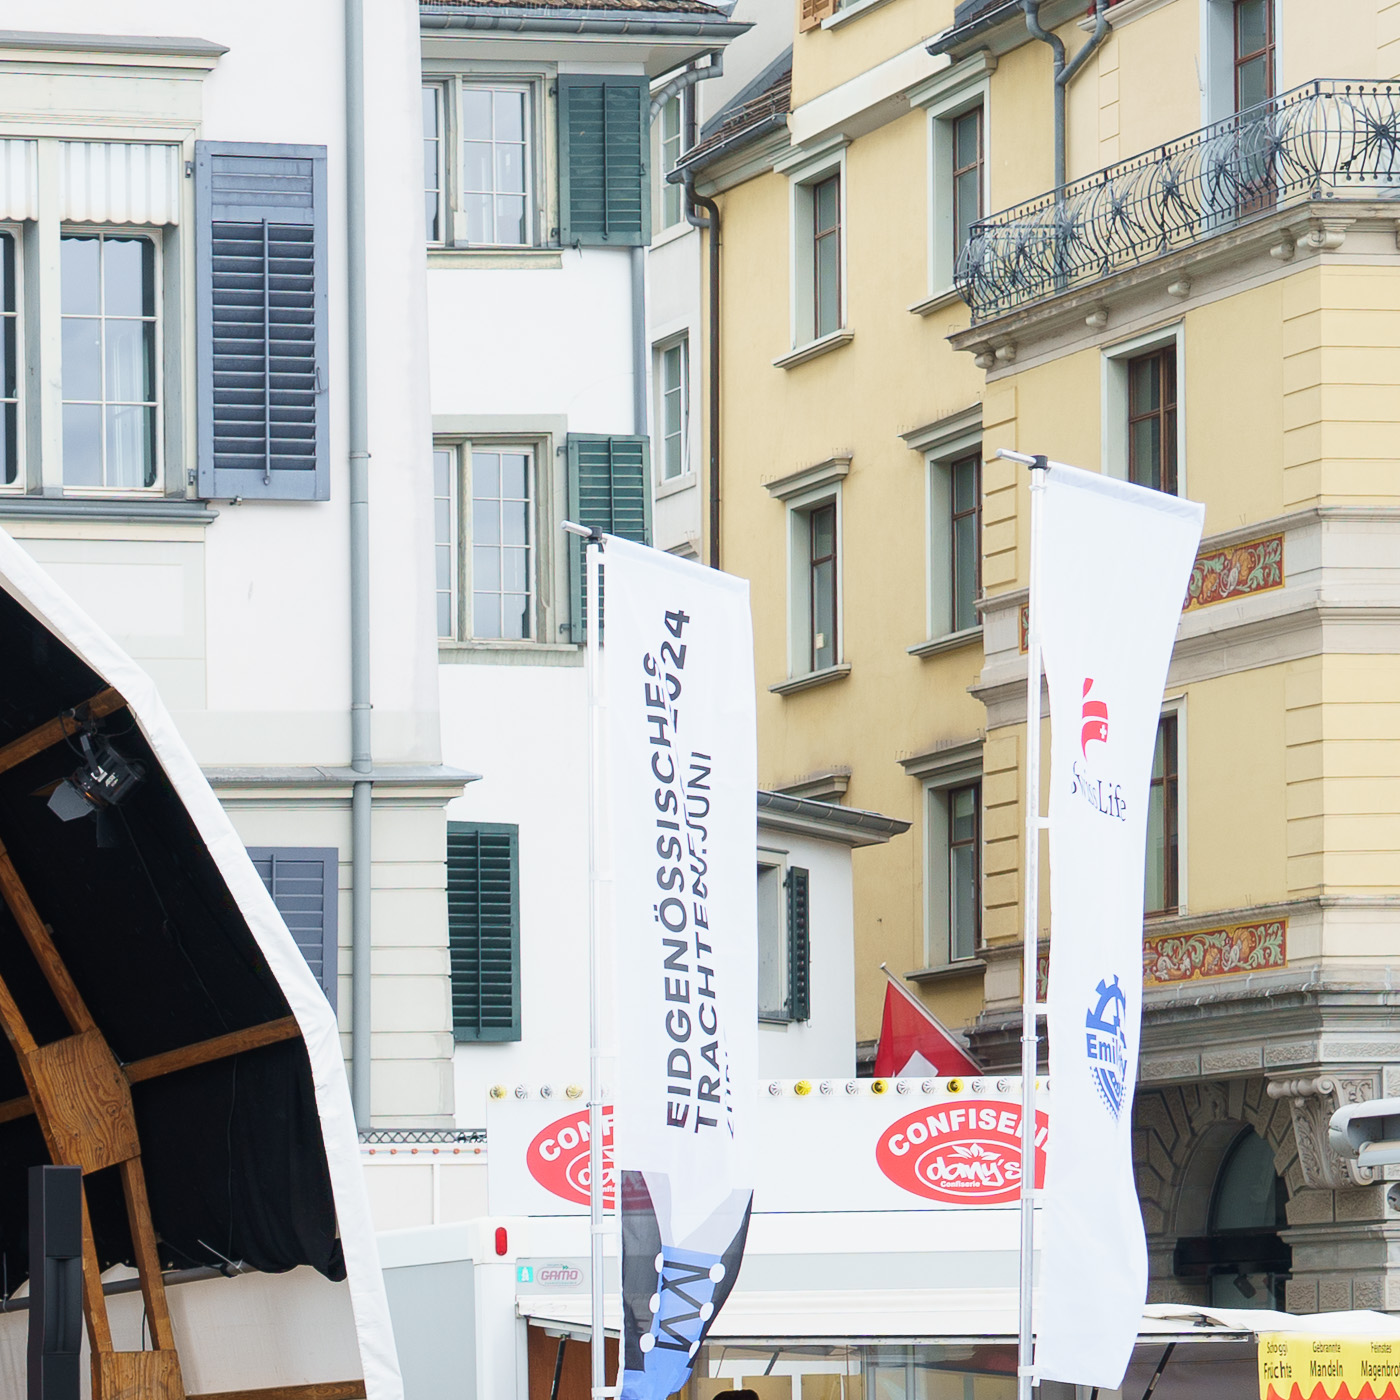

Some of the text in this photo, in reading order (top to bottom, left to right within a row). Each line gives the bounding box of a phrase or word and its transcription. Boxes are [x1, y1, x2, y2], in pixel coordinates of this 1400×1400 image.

[643, 652, 692, 1129] EIDGENÖSSISCHES
[888, 1108, 1048, 1156] CONFISEI
[940, 1180, 981, 1188] Confiserie
[541, 1270, 579, 1281] GAMO
[1313, 1341, 1341, 1353] Gebrannte
[1371, 1342, 1392, 1353] Feinstes
[1264, 1361, 1292, 1379] Früchte
[1310, 1360, 1343, 1377] Mandeln
